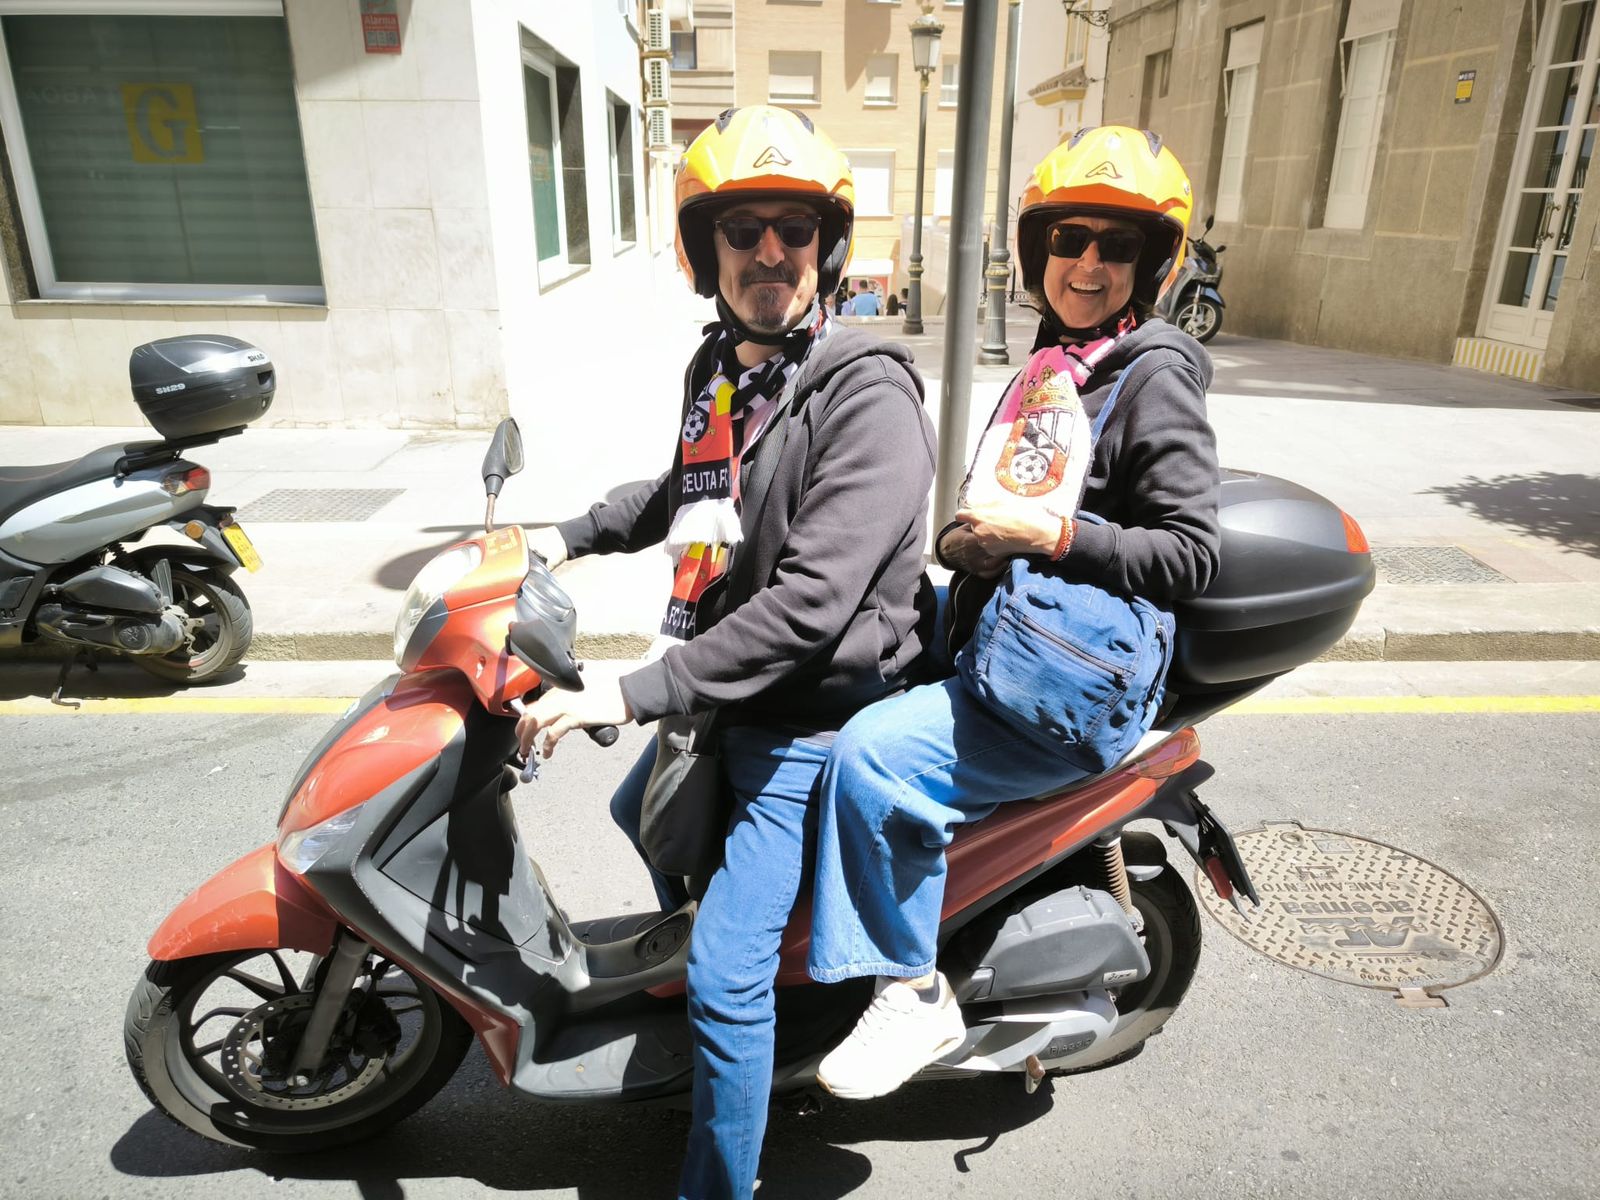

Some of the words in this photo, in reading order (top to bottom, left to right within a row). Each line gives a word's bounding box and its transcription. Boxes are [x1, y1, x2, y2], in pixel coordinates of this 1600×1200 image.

[364, 15, 397, 25] Alarma
[136, 88, 190, 158] G
[155, 383, 186, 395] SH29
[1261, 881, 1400, 893] SANEAMIENTO
[1279, 900, 1414, 915] acemsa
